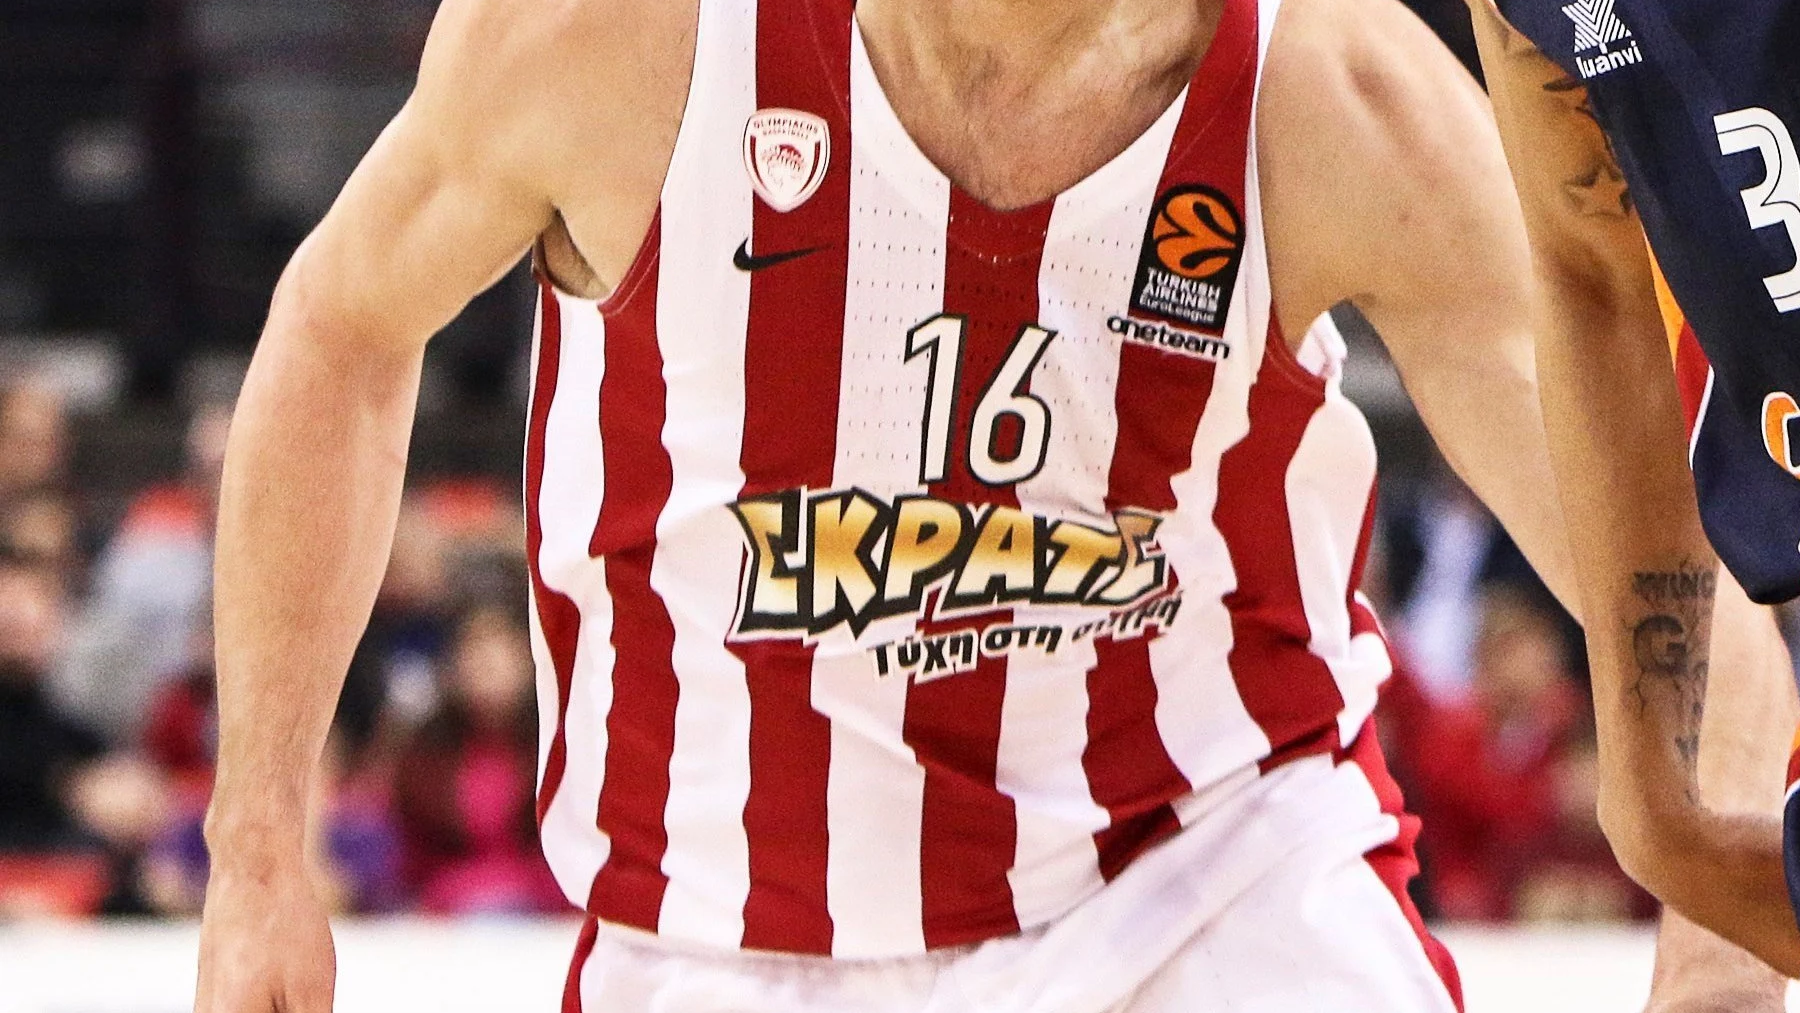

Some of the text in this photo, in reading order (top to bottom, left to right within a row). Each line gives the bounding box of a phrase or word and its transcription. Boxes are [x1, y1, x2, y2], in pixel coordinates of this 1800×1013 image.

[1575, 40, 1643, 79] luanvi
[753, 117, 818, 134] OLYMPIACOS
[1141, 283, 1218, 313] AIRLINES
[1148, 267, 1220, 299] TURKISH
[1139, 294, 1215, 323] EuroLeague
[1107, 315, 1230, 359] oneteam
[904, 313, 1056, 486] 16
